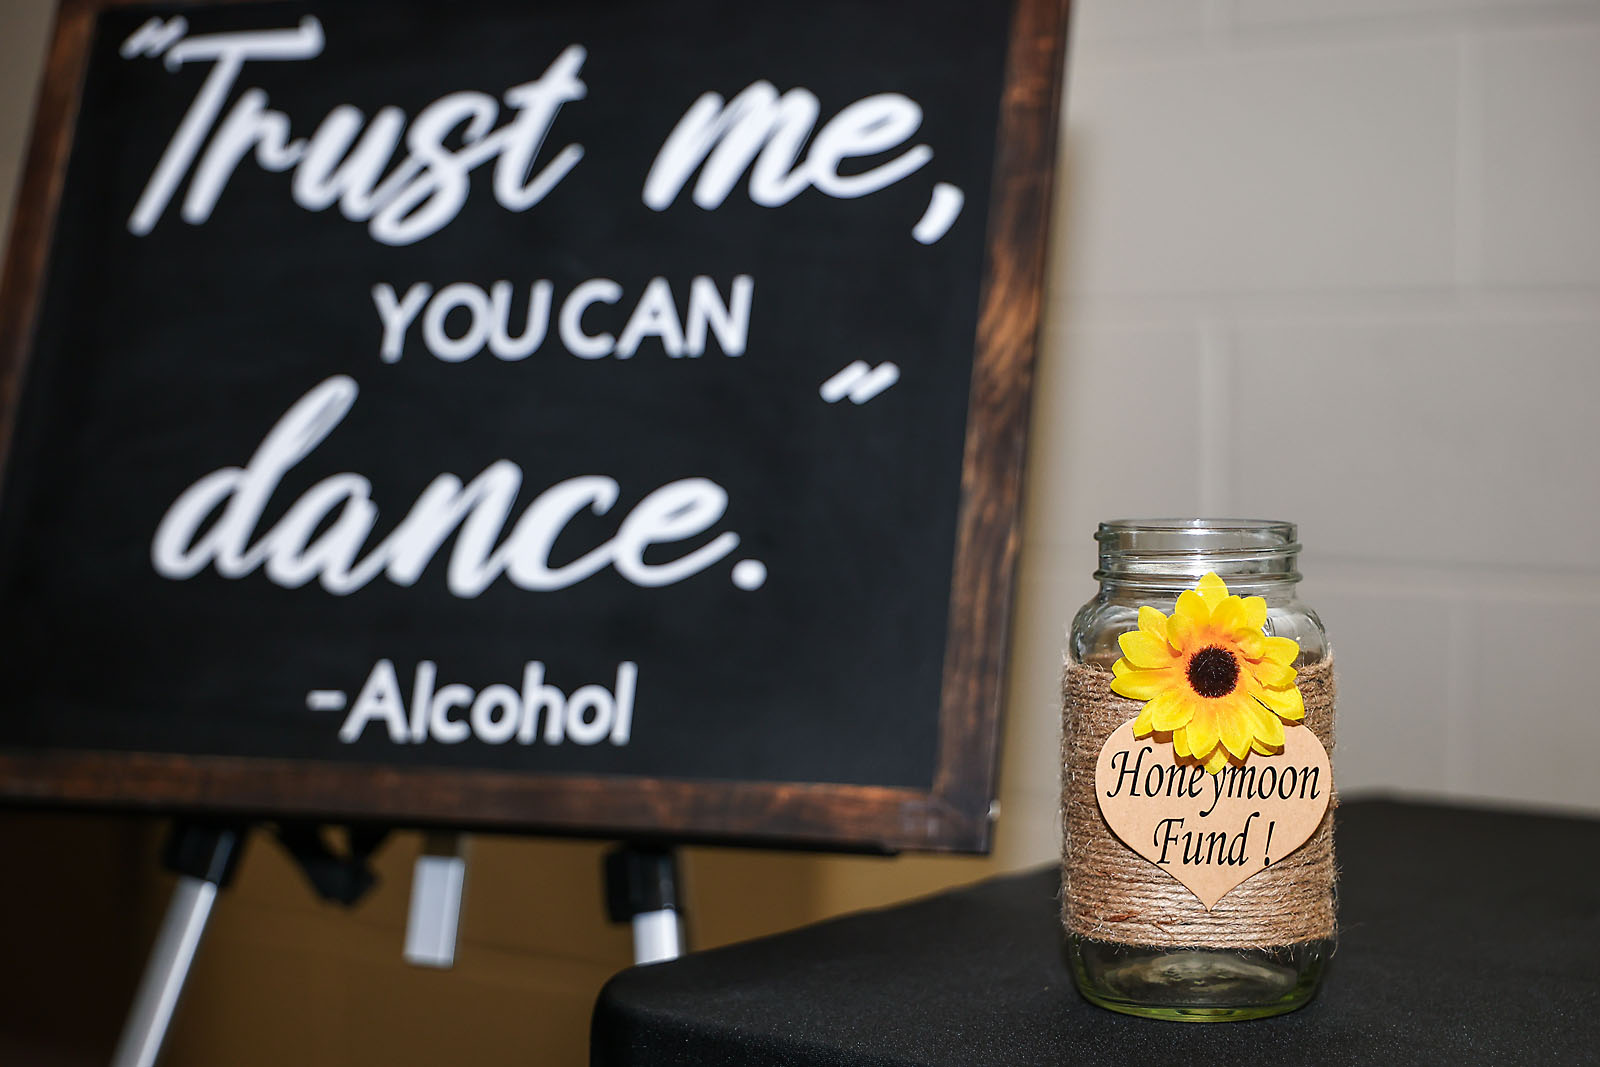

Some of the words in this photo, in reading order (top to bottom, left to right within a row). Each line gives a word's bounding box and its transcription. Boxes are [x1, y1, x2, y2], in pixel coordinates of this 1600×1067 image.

[642, 80, 964, 244] me,
[371, 277, 554, 364] YOU
[558, 273, 756, 362] CAN
[306, 659, 638, 746] -Alcohol
[1106, 746, 1321, 818] Honeymoon
